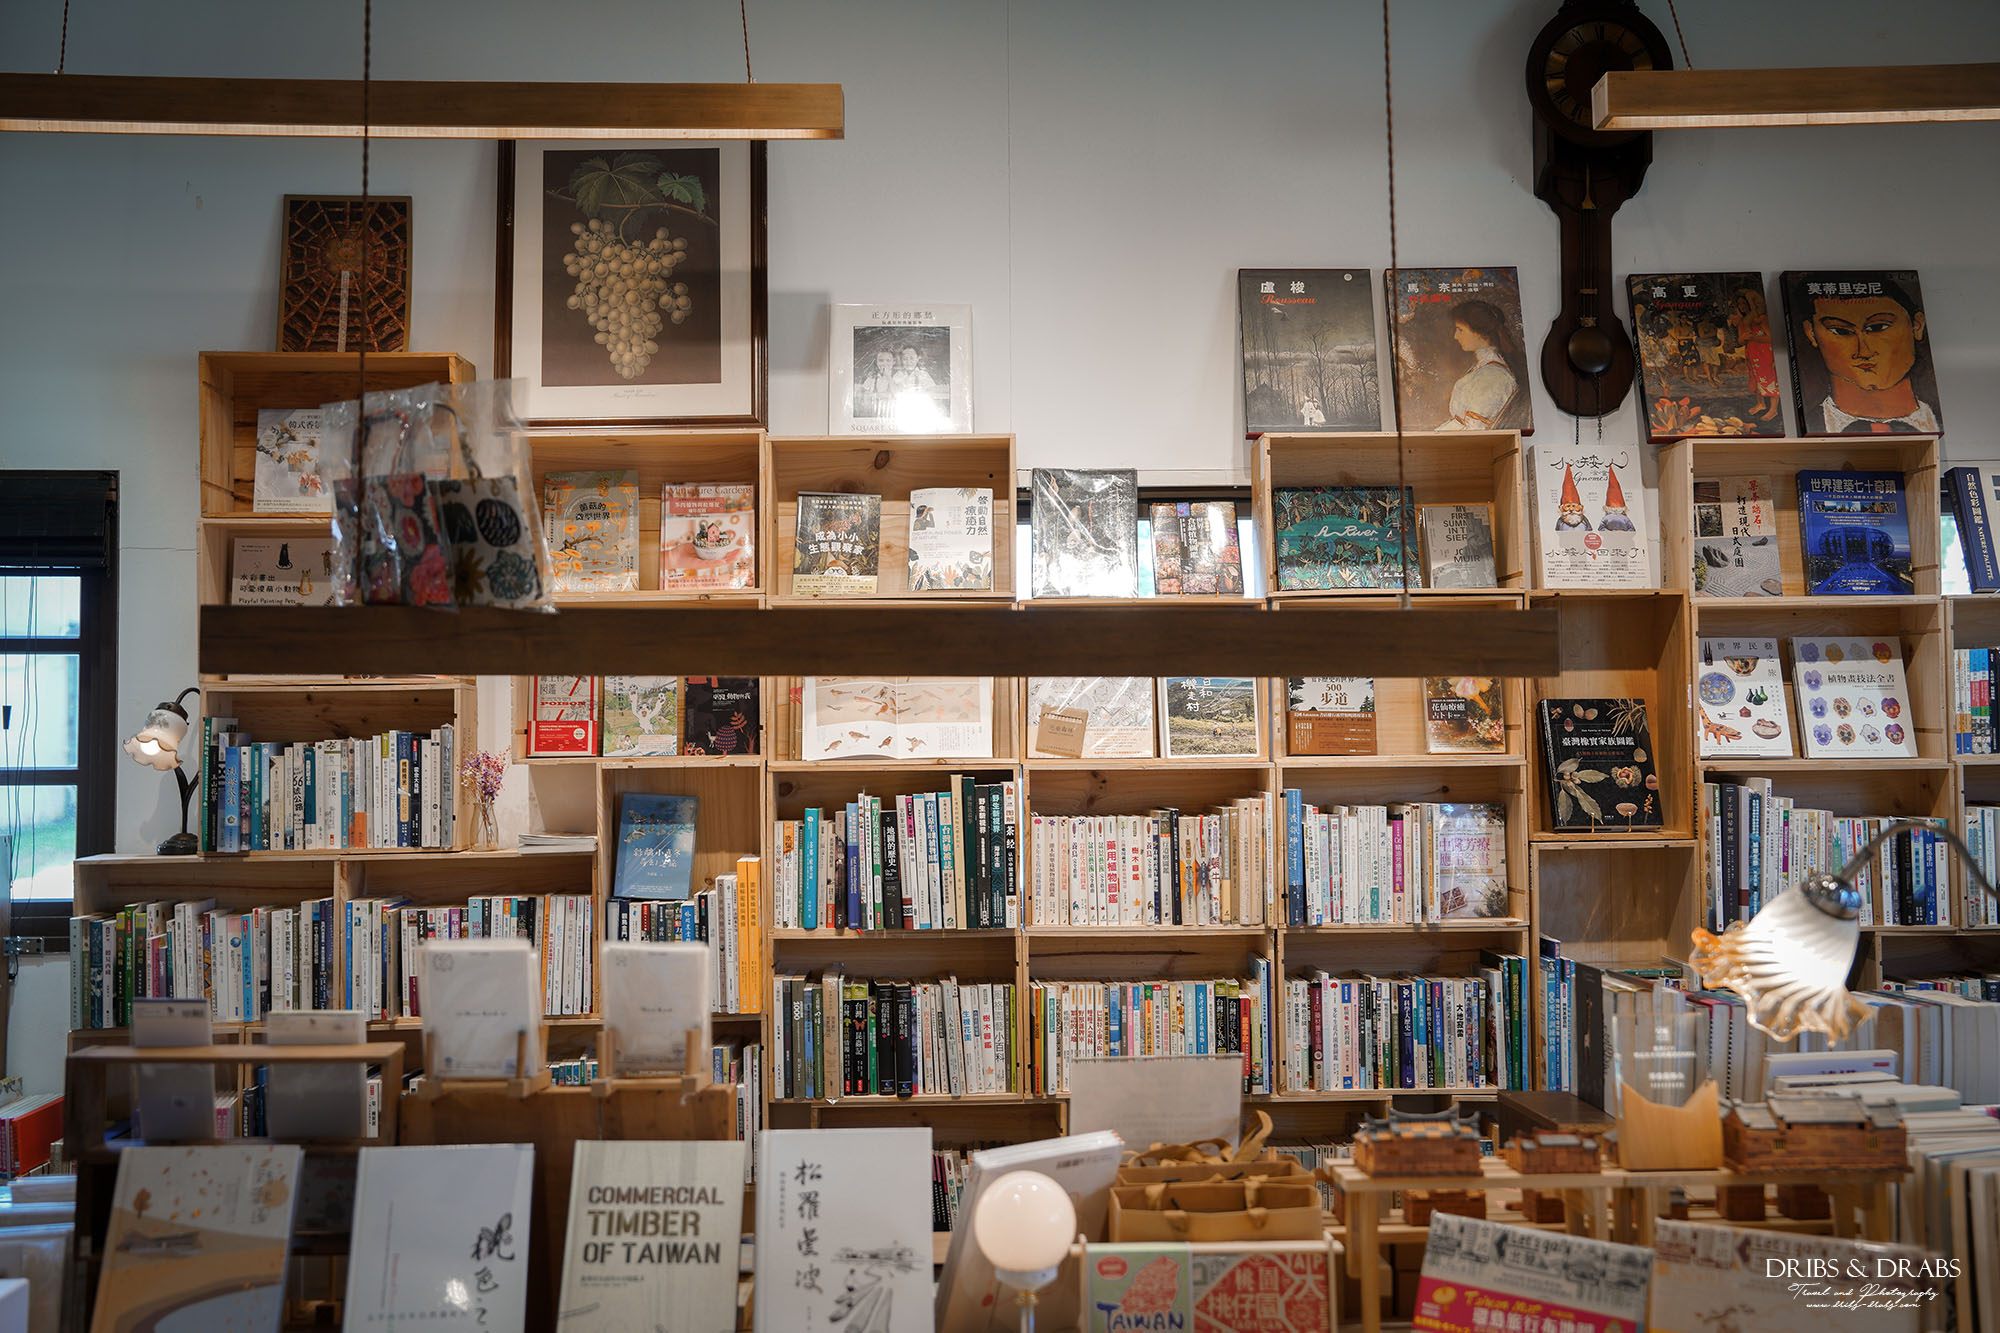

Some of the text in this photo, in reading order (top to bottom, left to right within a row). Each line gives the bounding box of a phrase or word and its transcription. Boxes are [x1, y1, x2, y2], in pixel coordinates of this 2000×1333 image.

[1260, 281, 1305, 294] 盧梭
[1408, 282, 1451, 293] 馬奈
[1651, 285, 1698, 299] 高更
[1807, 282, 1883, 295] 莫蒂里安尼
[1261, 294, 1316, 304] Rousseau
[715, 486, 753, 494] Gardens
[1810, 478, 1897, 494] 世界建築七十奇蹟
[1341, 526, 1378, 537] River
[1454, 555, 1480, 563] MUIR
[1325, 683, 1342, 692] 500
[1321, 692, 1348, 706] 步道
[587, 1185, 724, 1206] COMMERCIAL
[586, 1210, 702, 1237] TIMBER
[582, 1242, 721, 1265] OF TAIWAN
